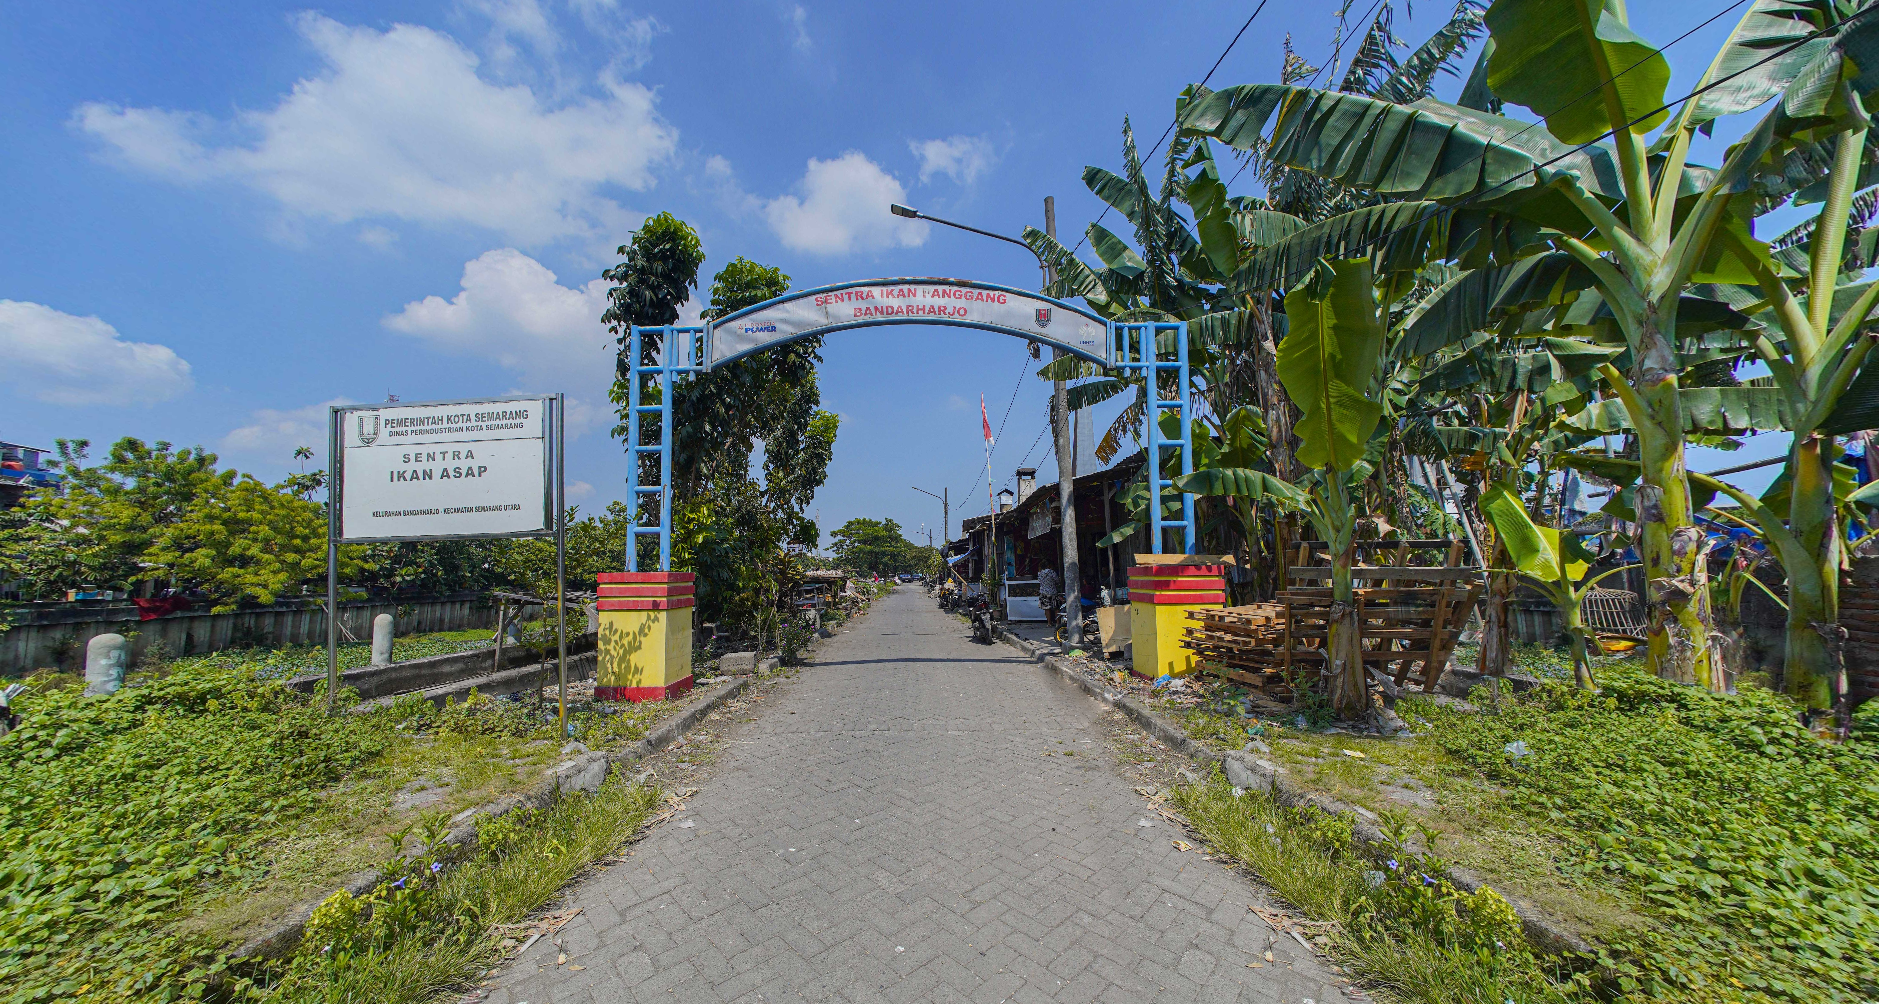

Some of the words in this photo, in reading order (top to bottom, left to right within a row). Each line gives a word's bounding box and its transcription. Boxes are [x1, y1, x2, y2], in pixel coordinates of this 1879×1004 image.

[814, 289, 875, 307] SENTRA
[880, 287, 917, 299] IKAN
[853, 304, 968, 318] BANDARHARJO
[384, 414, 444, 429] PEMERINTAH
[446, 413, 472, 425] KOTA
[474, 409, 529, 423] SEMARANG
[388, 429, 409, 438] DINAS
[410, 426, 464, 436] PERINDUSTRIAN
[465, 424, 484, 433] KOTA
[485, 421, 524, 431] SEMARANG
[402, 449, 475, 464] SENTRA
[389, 468, 433, 483] IKAN
[439, 465, 488, 480] ASAP
[372, 510, 402, 518] KELURAHAN
[443, 506, 474, 515] KECAMATAN
[474, 504, 503, 513] SEMARANG
[503, 503, 521, 512] UTARA
